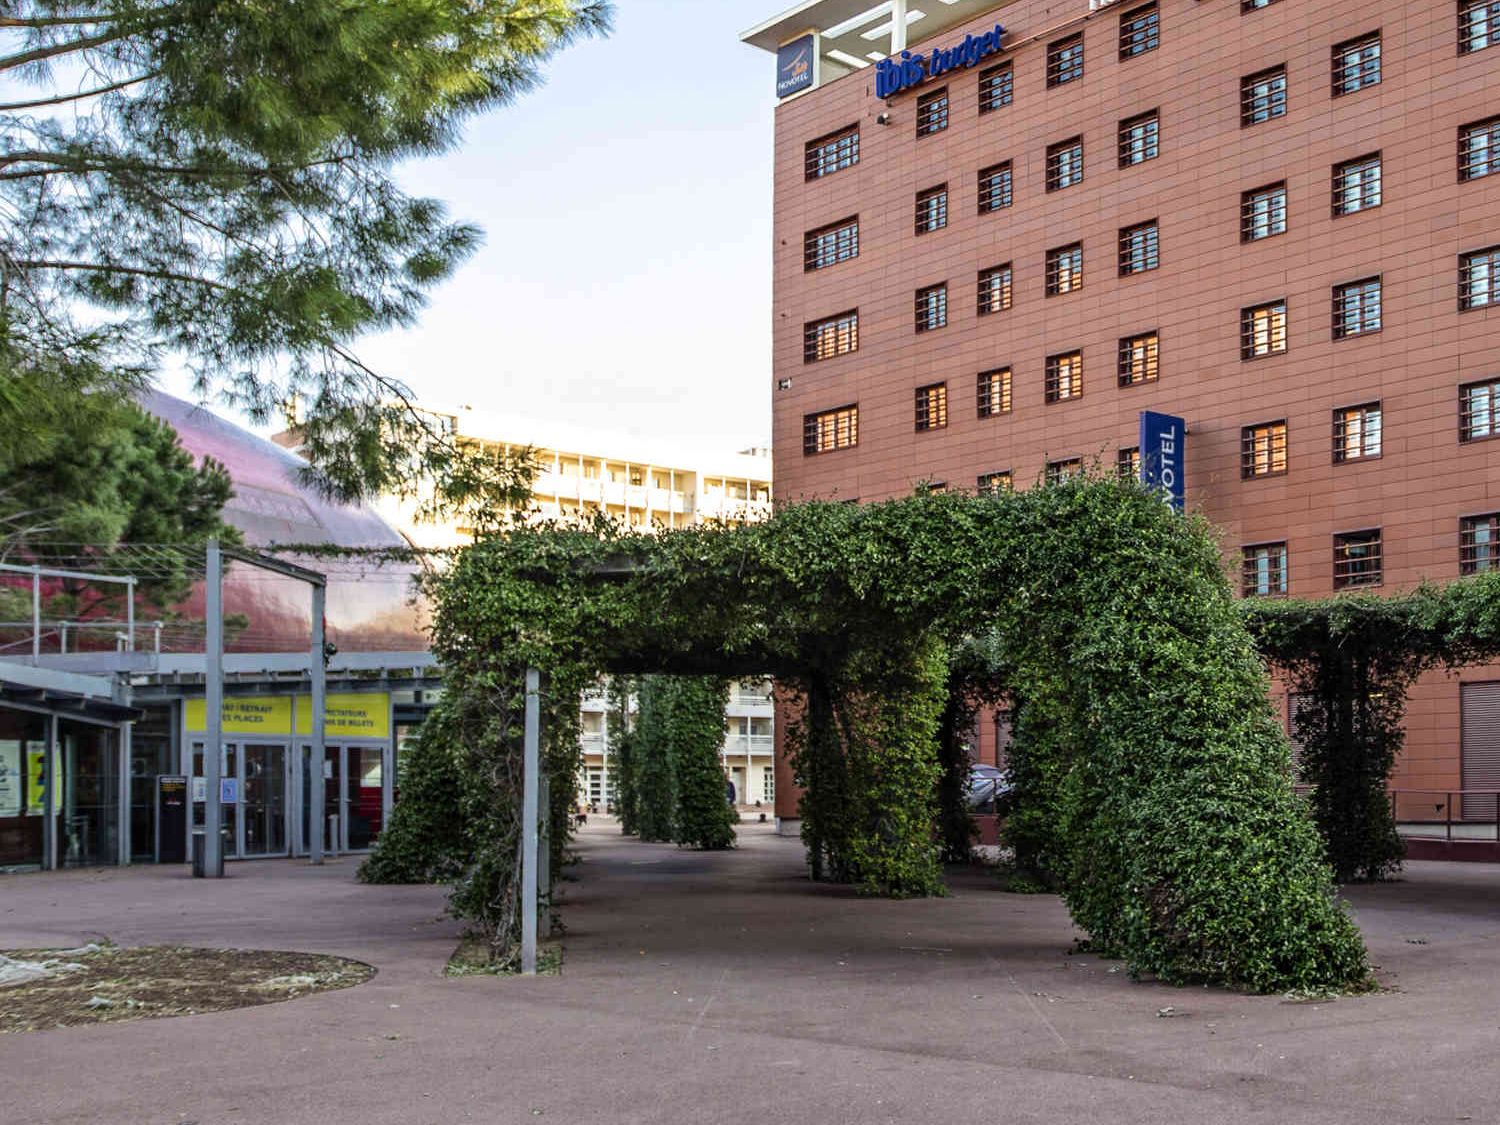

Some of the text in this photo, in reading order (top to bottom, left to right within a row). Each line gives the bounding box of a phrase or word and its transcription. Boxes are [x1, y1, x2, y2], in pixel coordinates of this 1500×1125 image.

[778, 72, 809, 91] NOVOTEL
[875, 24, 1004, 99] ibis budget
[1160, 425, 1175, 515] VOTEL
